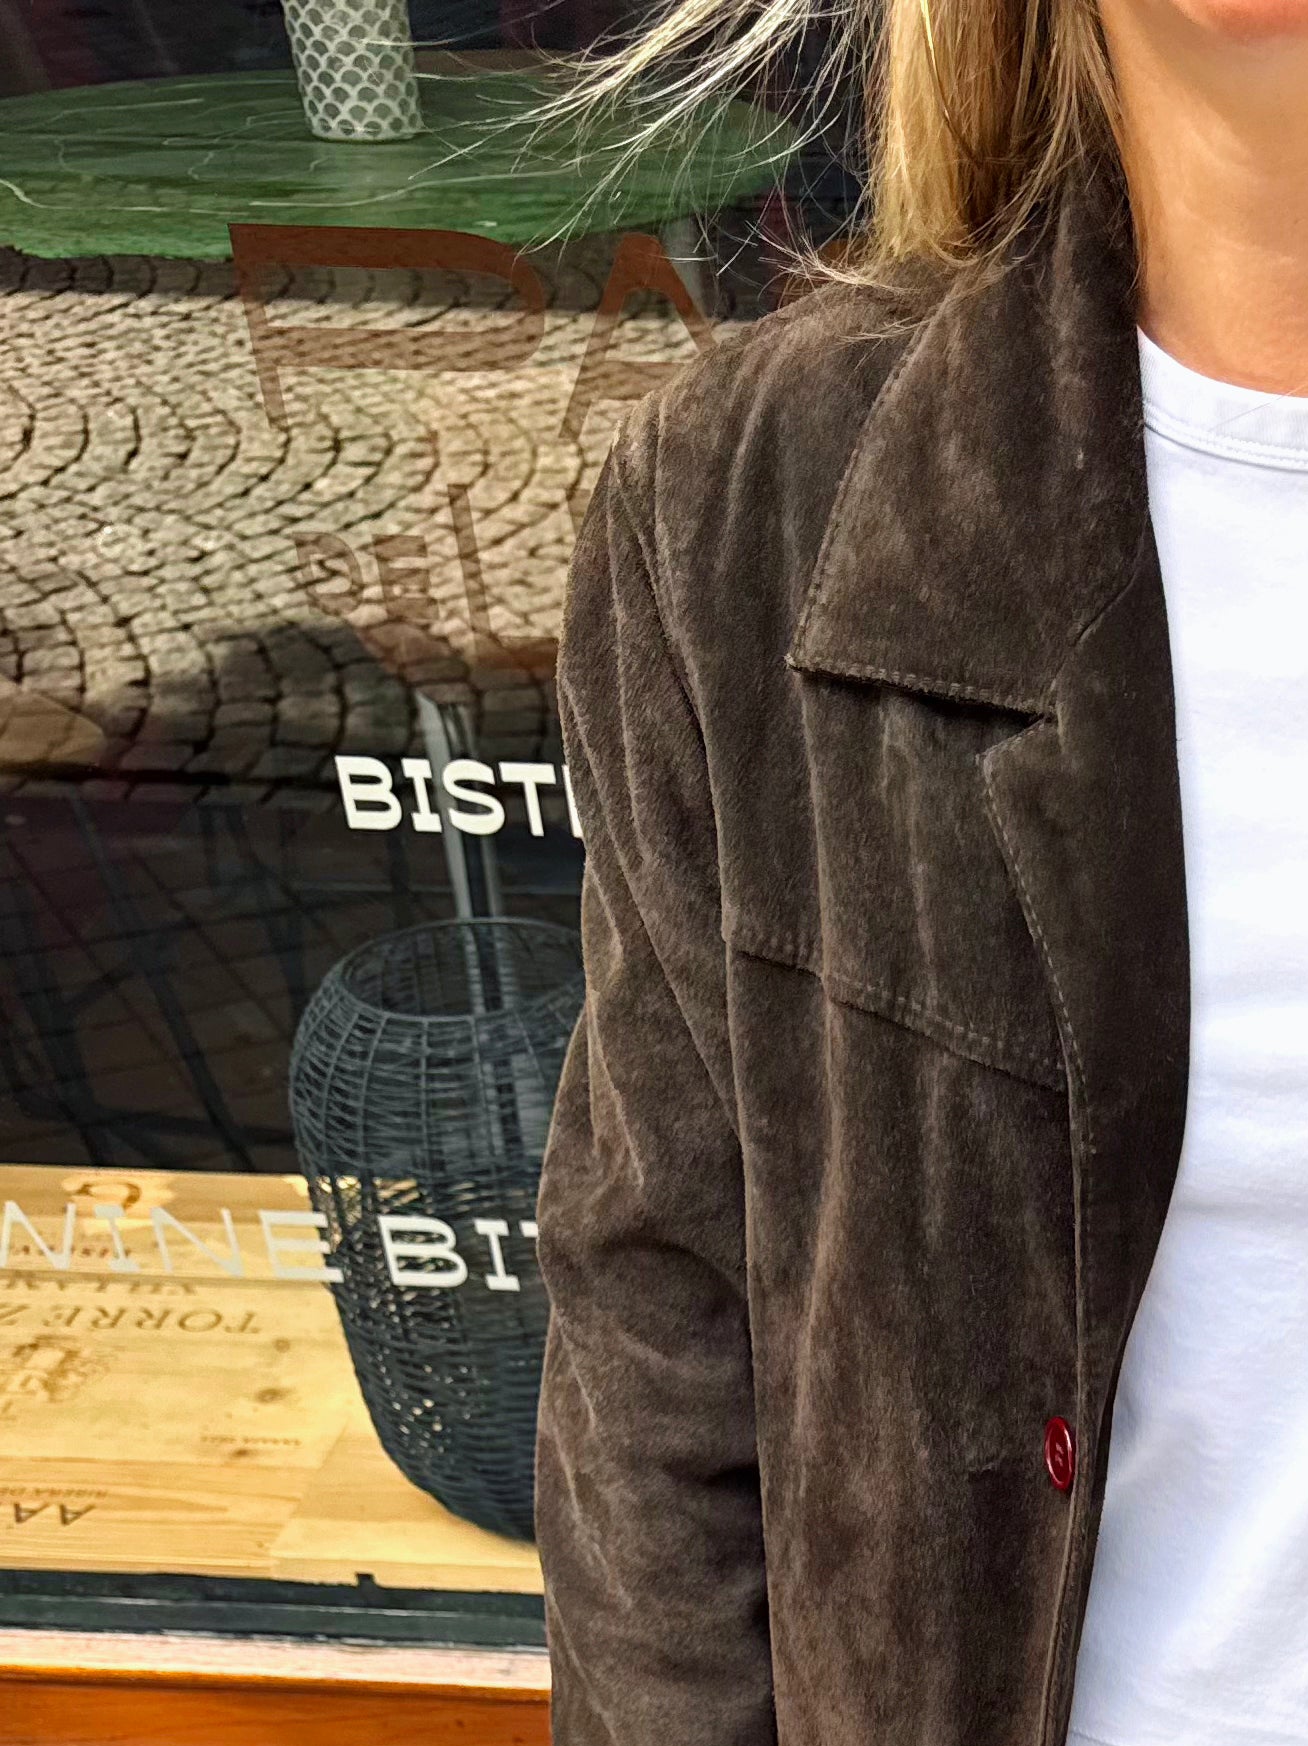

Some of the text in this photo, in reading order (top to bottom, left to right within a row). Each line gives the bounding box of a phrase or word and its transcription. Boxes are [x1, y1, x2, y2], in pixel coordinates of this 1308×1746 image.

[448, 484, 592, 672] L
[335, 755, 583, 838] BIST
[42, 1304, 262, 1333] TORRE
